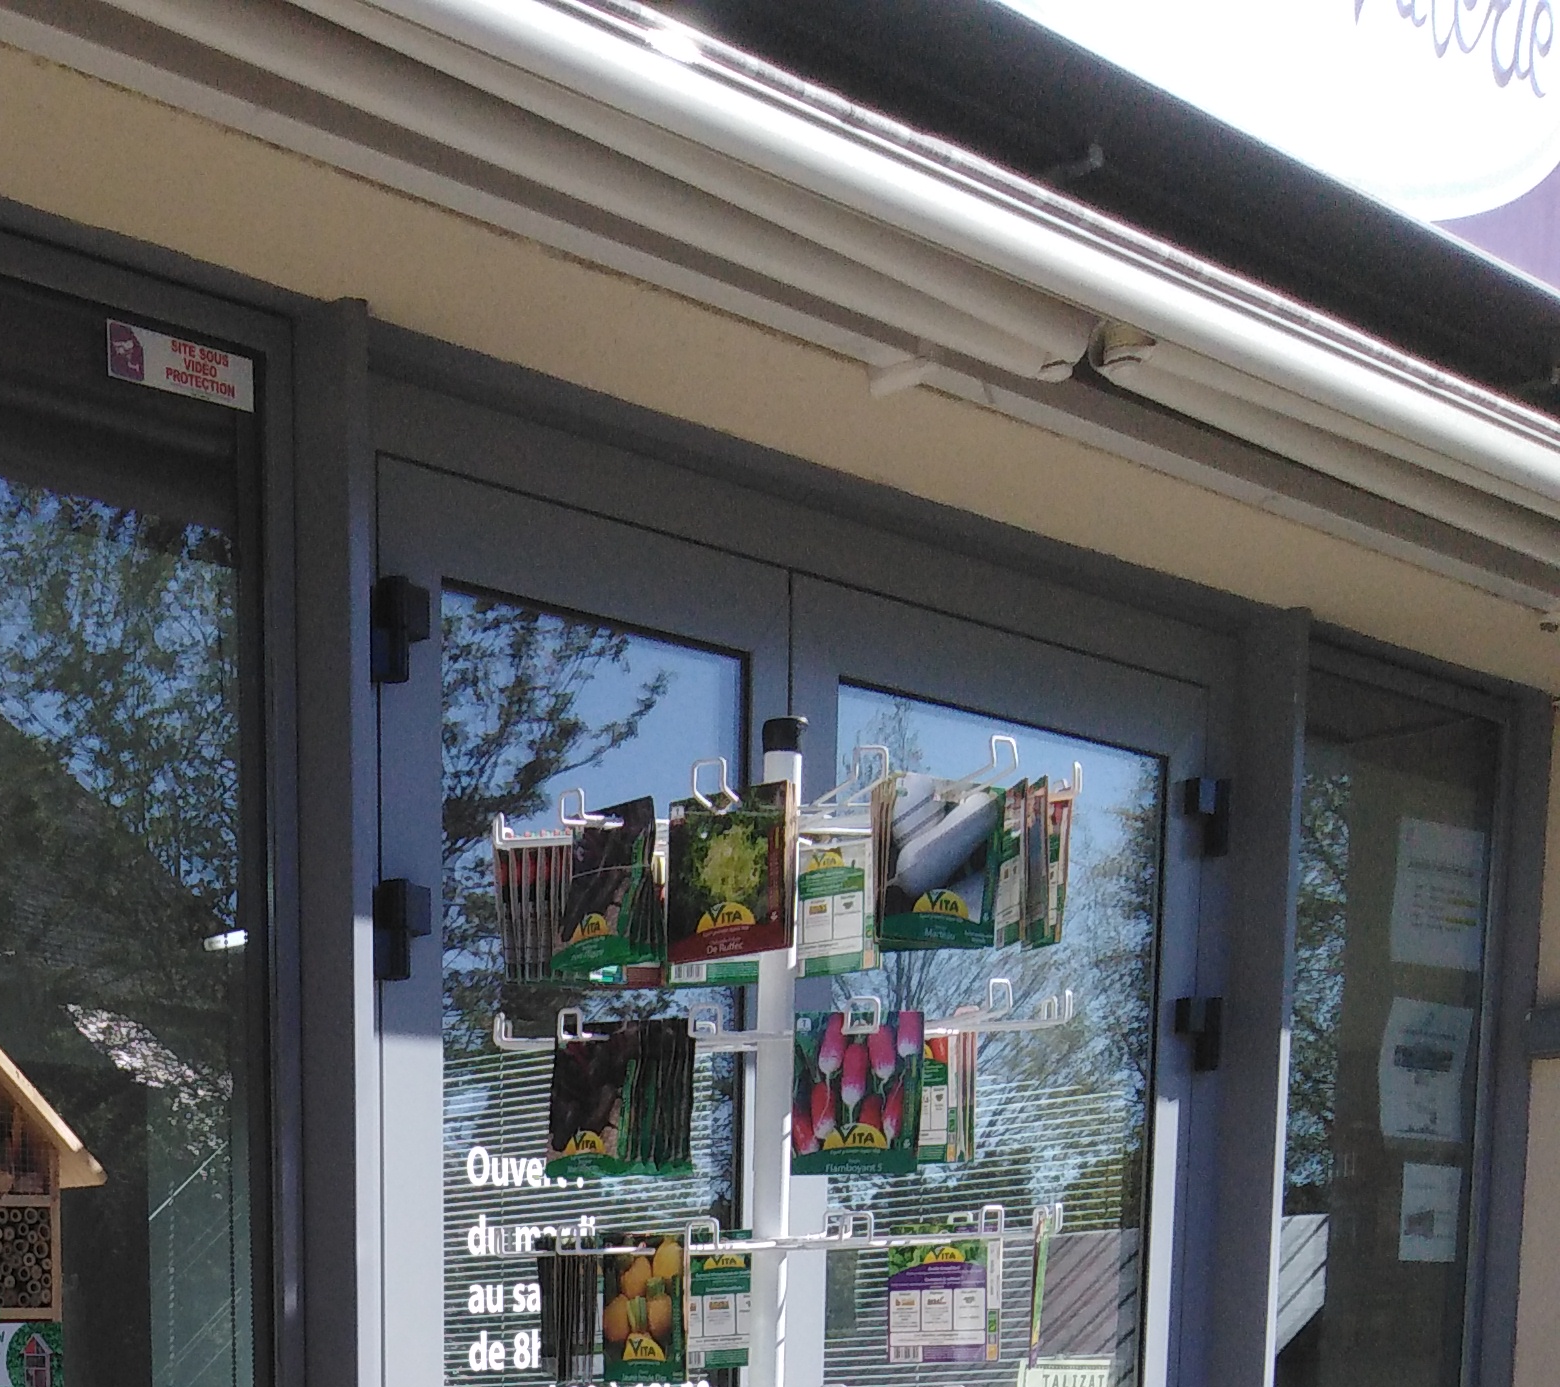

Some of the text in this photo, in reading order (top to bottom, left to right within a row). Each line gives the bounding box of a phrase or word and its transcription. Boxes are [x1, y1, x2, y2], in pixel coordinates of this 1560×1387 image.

[171, 339, 229, 367] SITE SOUS
[165, 366, 235, 399] PROTECTION
[926, 890, 959, 912] VITA
[710, 902, 743, 926] VITA
[839, 1124, 875, 1144] VITA
[825, 1162, 876, 1174] Flamboyant
[931, 1246, 956, 1260] VITA
[468, 1283, 504, 1314] au
[468, 1330, 506, 1371] de
[630, 1337, 656, 1357] VITA
